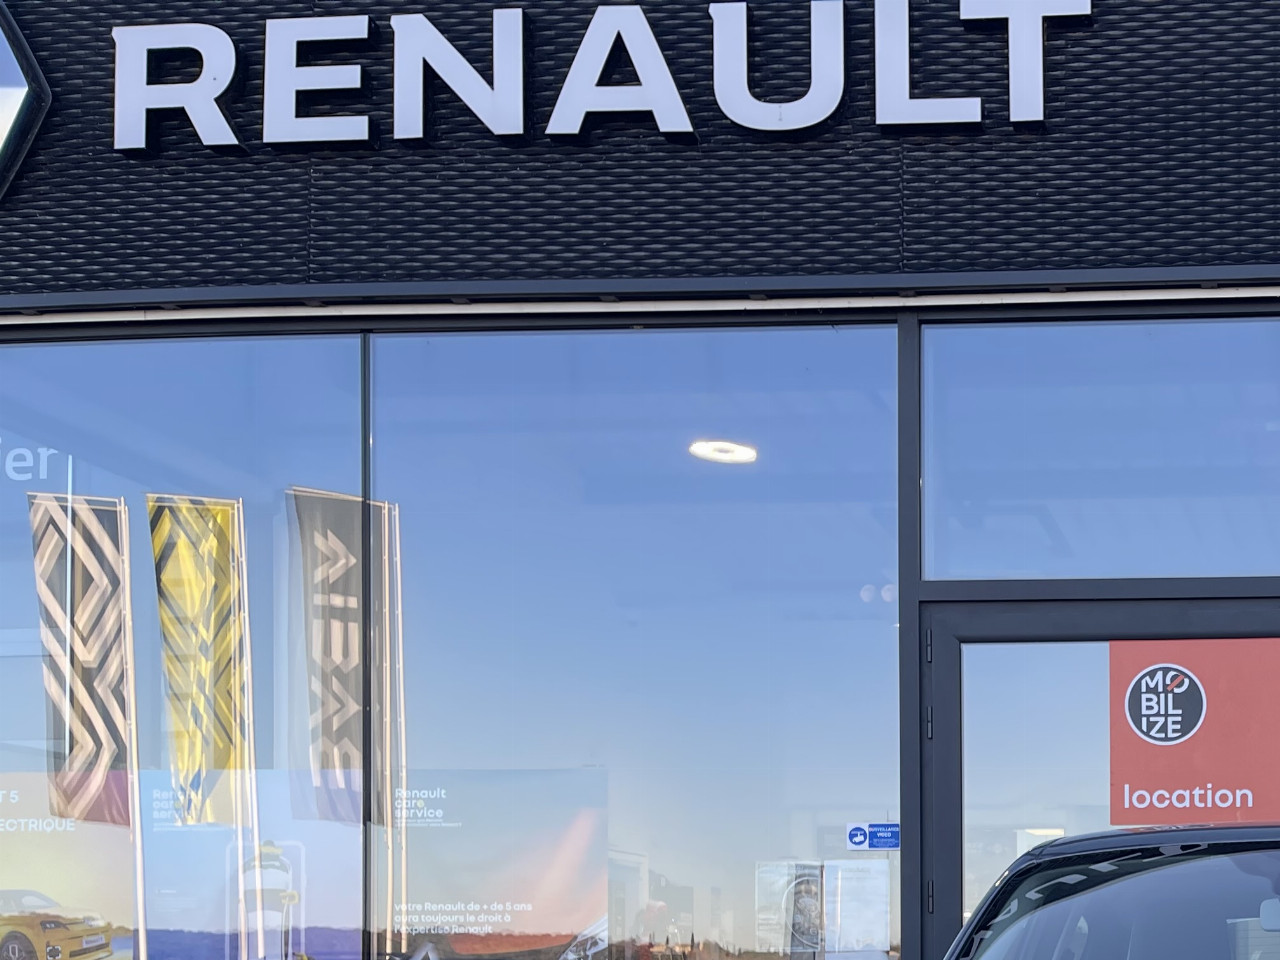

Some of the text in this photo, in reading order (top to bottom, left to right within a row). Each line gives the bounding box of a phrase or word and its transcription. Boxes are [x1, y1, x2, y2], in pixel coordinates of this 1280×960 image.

[111, 0, 1094, 151] RENAULT
[395, 788, 446, 799] Renault
[1124, 783, 1253, 808] location
[395, 808, 443, 818] service
[424, 901, 466, 911] Renault
[466, 901, 481, 911] de
[490, 901, 504, 911] de
[513, 902, 533, 911] ans
[421, 913, 465, 924] toujours
[466, 913, 476, 922] le
[477, 913, 503, 922] droit
[451, 924, 493, 935] Renault
